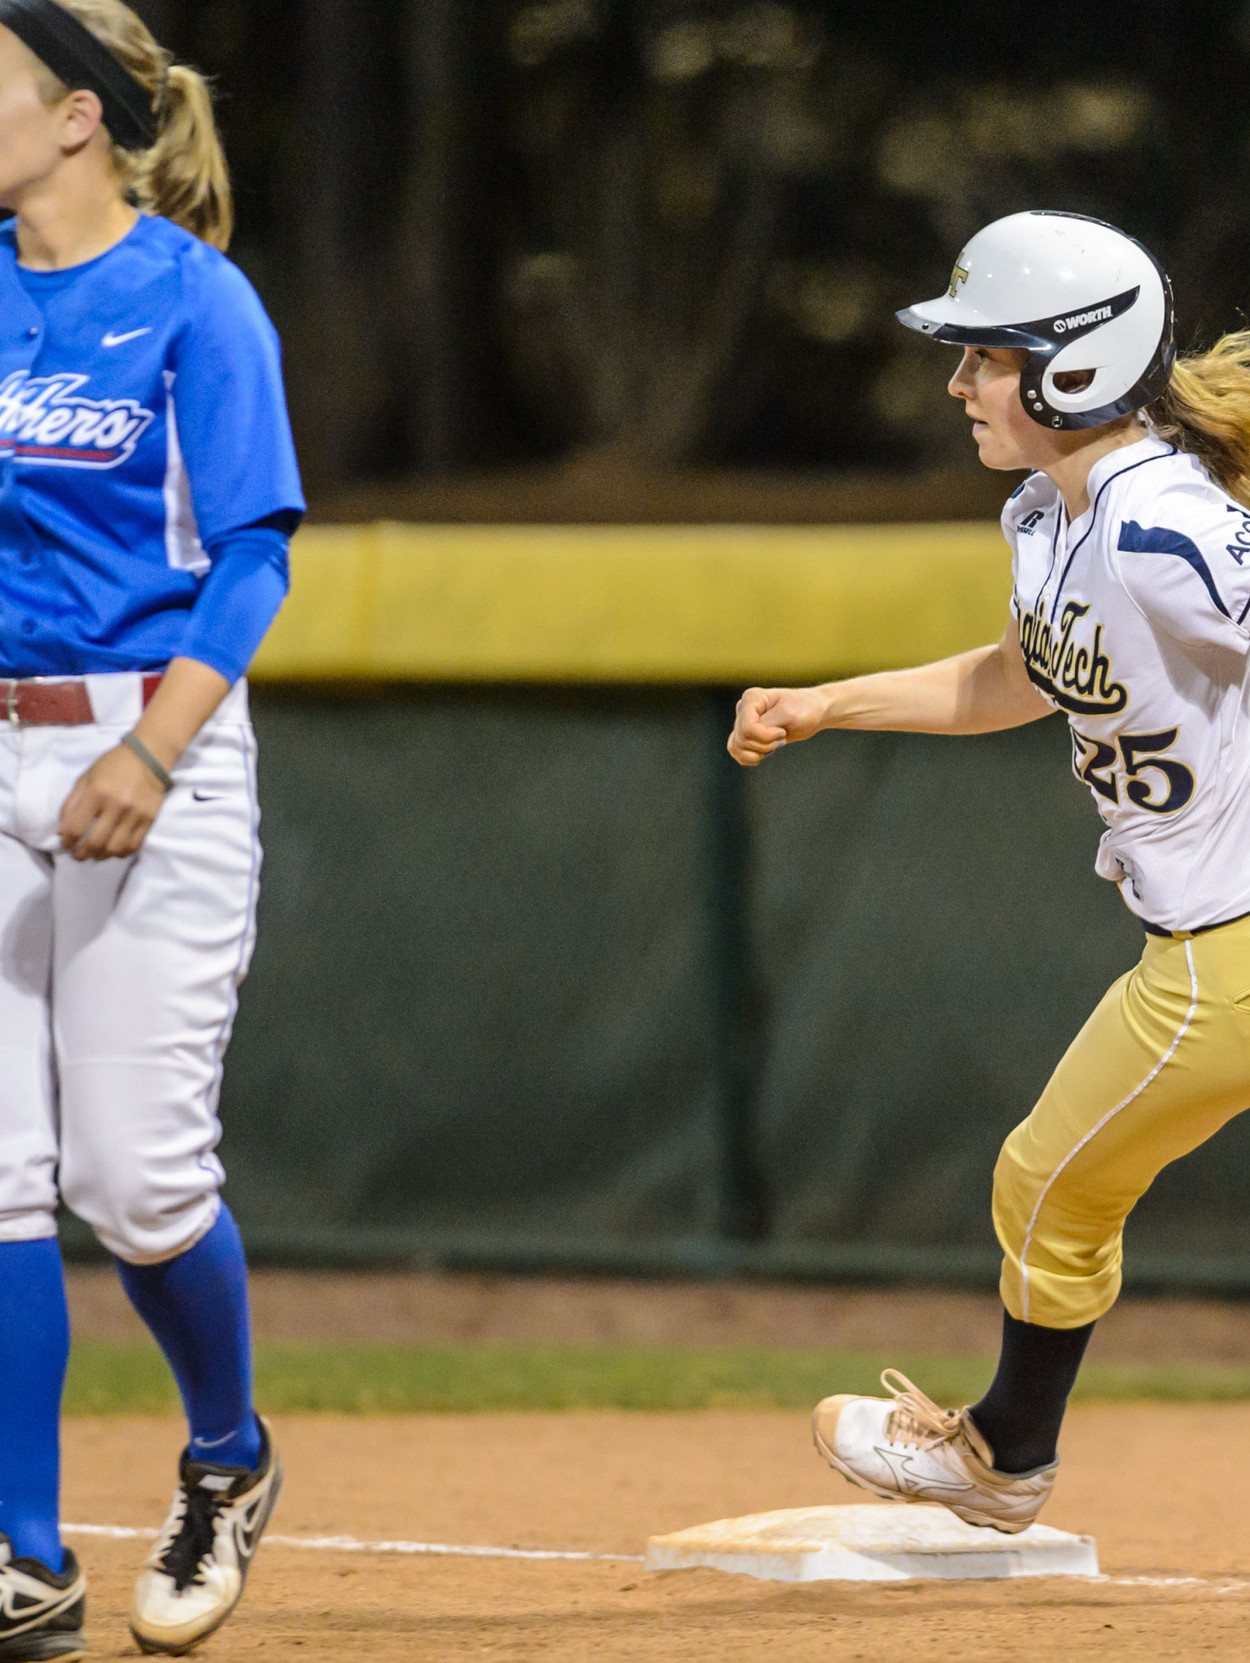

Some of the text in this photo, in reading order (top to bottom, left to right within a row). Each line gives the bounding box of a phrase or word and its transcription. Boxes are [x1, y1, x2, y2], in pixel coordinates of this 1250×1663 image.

[1065, 305, 1112, 330] WORTH
[1051, 599, 1123, 703] Tech
[1072, 725, 1197, 817] 25
